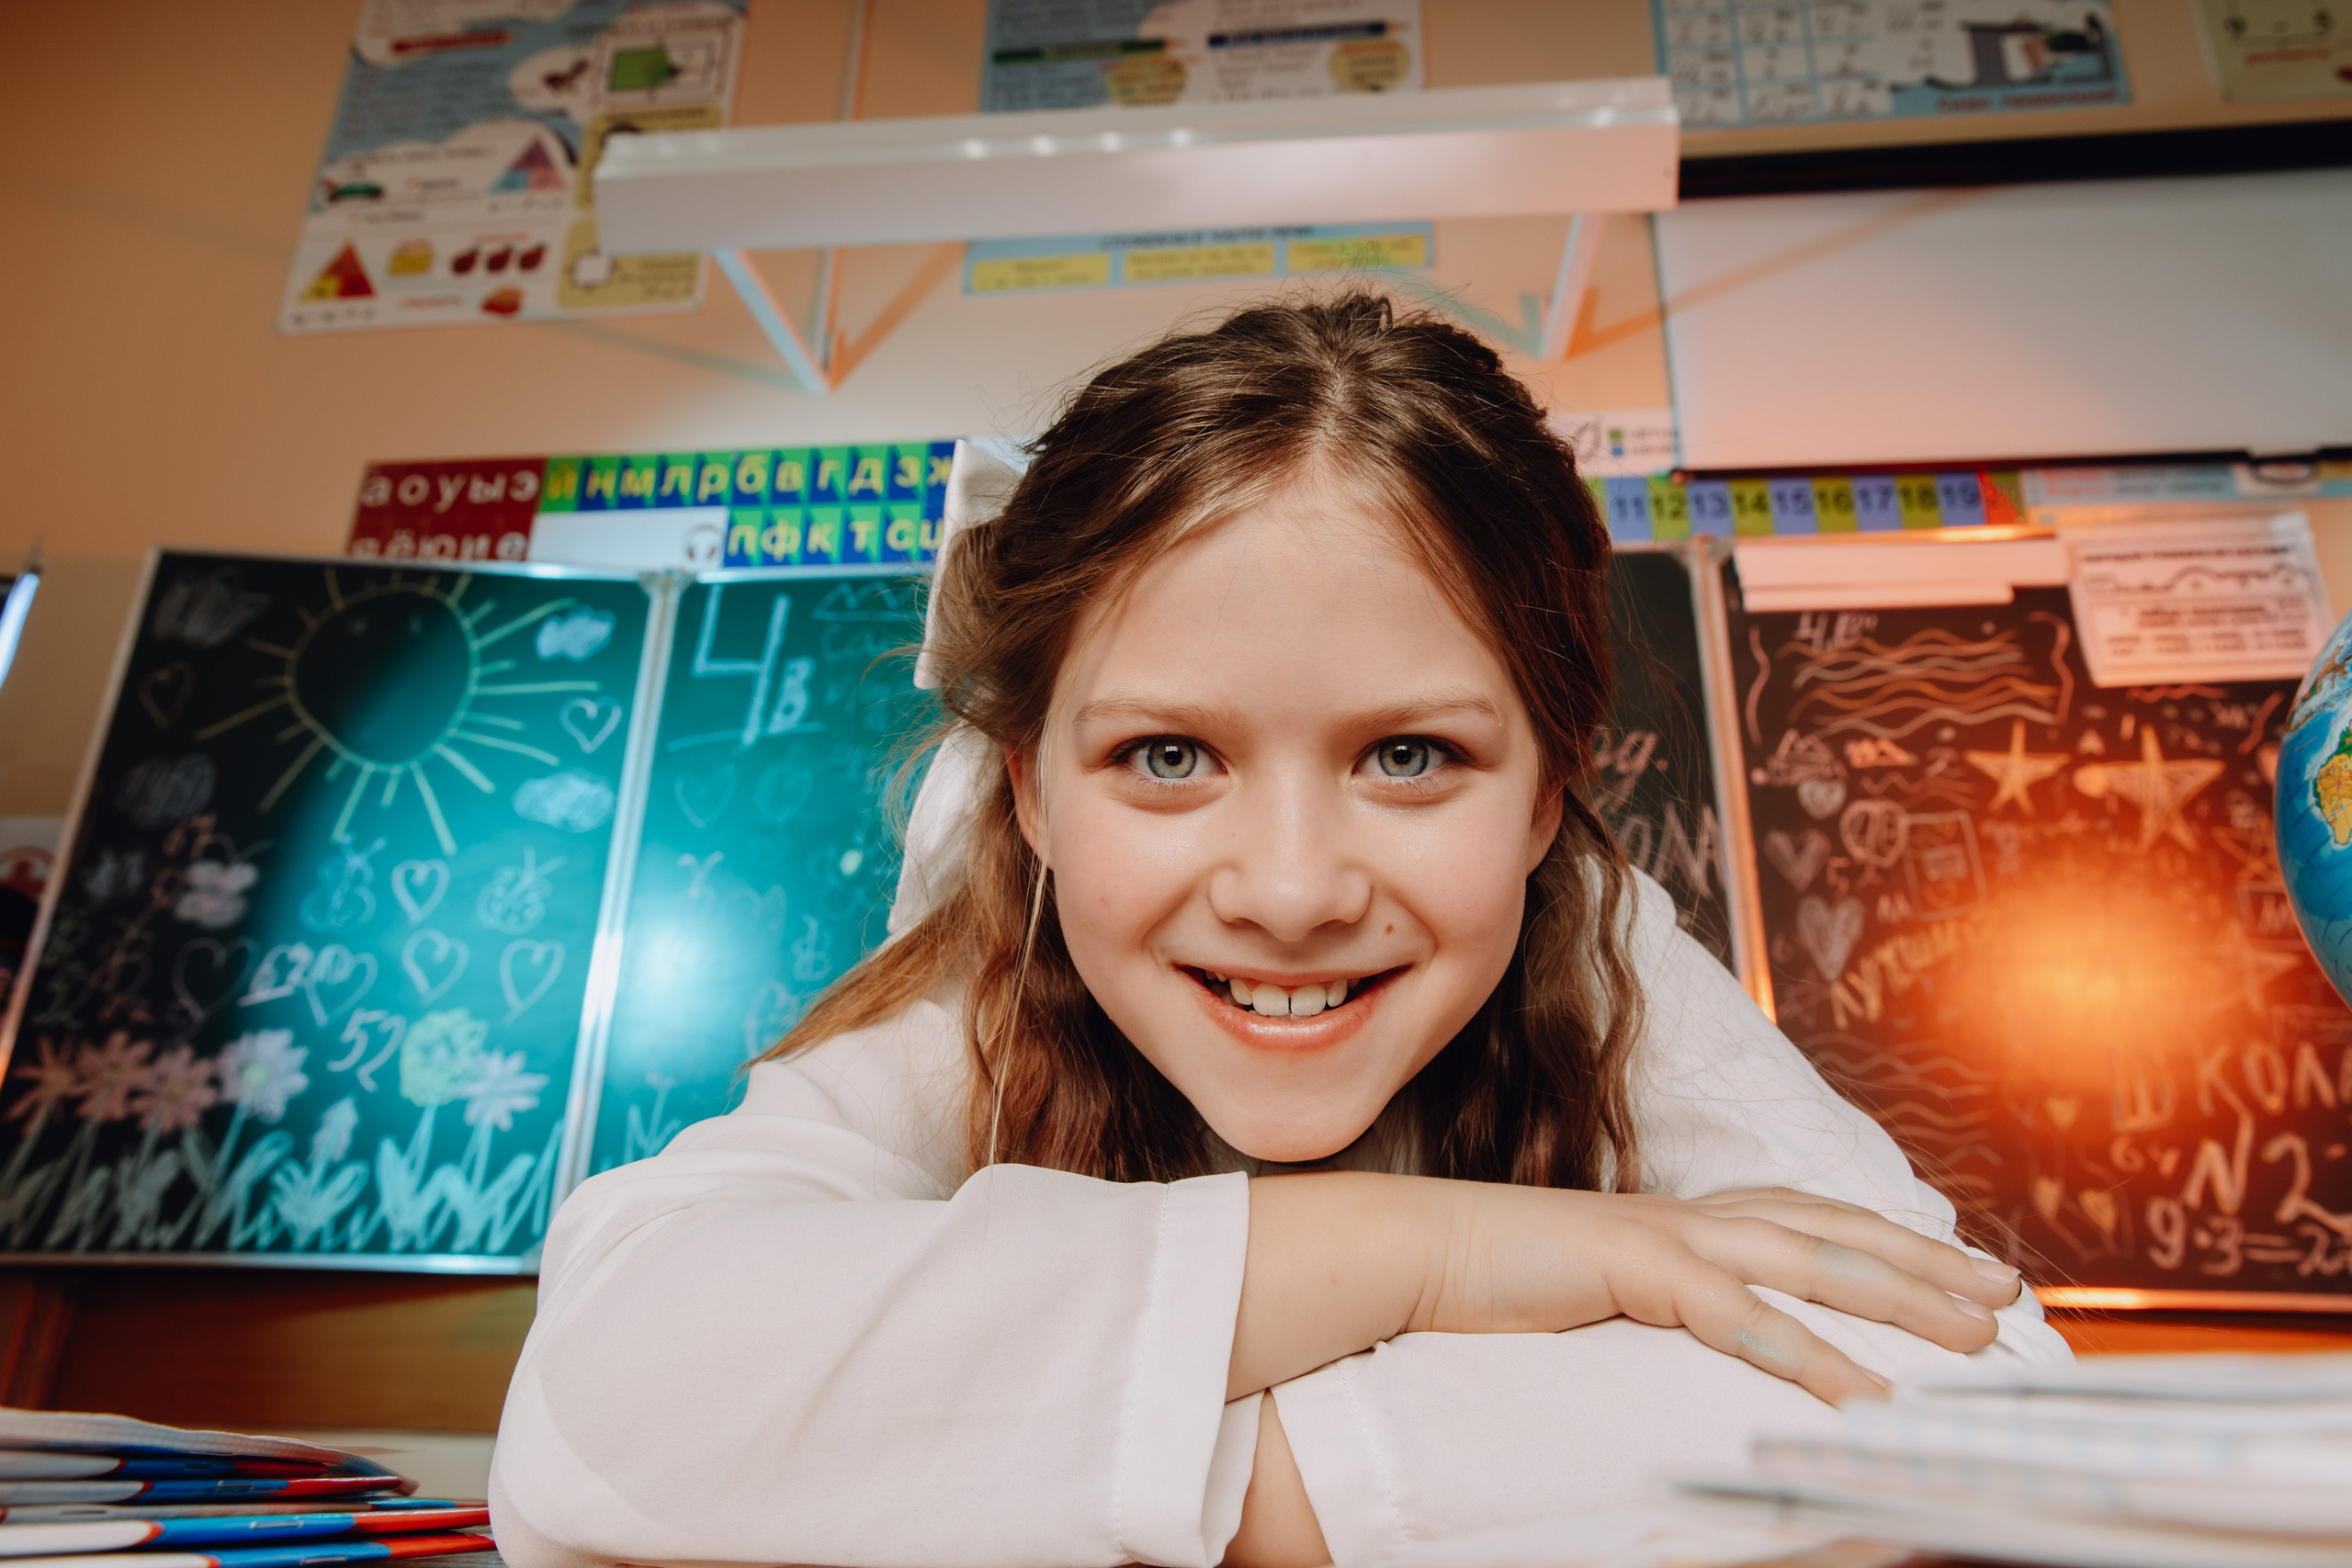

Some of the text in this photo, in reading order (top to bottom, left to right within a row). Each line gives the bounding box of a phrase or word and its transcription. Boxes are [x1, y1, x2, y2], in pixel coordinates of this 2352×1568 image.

[1651, 491, 1687, 520] 12
[1693, 489, 1731, 519] 13
[1736, 489, 1769, 517] 14
[1775, 486, 1814, 518] 15
[1817, 484, 1852, 515] 16
[1858, 483, 1894, 513] 17
[1902, 481, 1938, 513] 18
